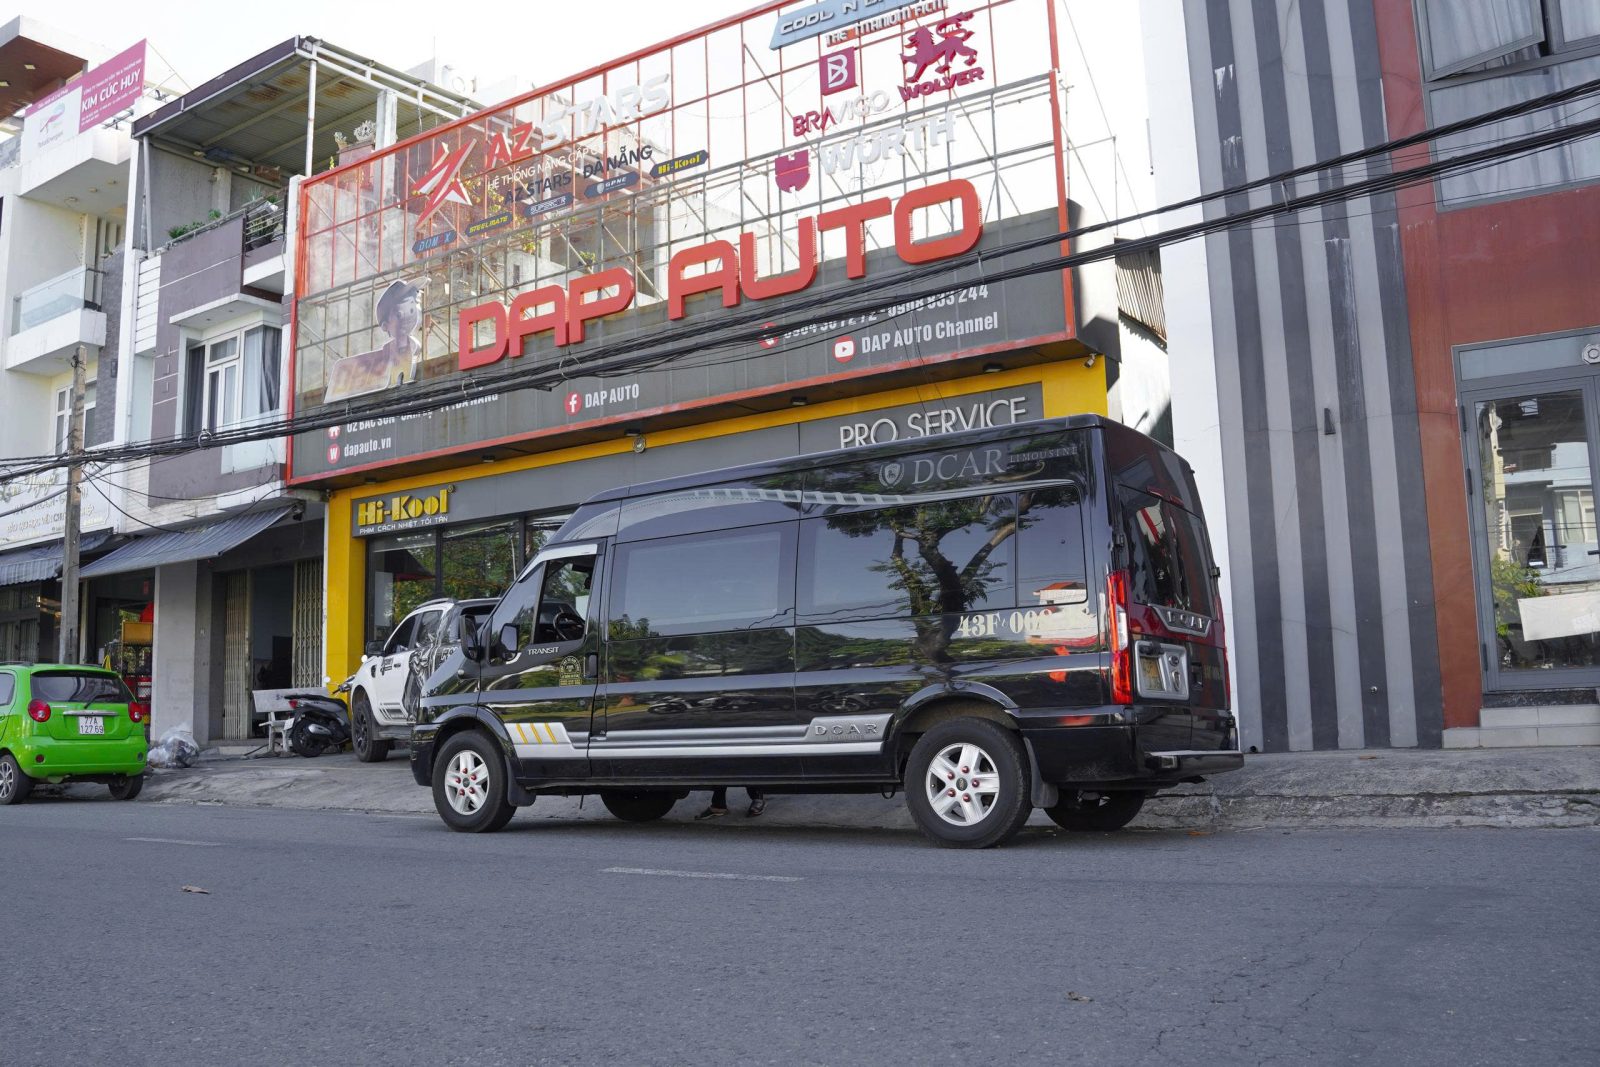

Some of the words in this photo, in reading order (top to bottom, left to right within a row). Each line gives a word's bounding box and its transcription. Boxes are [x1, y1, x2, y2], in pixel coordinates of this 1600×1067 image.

[779, 11, 834, 35] COOL
[81, 93, 98, 112] KIM
[99, 81, 119, 103] CÚC
[120, 68, 141, 91] HUY
[897, 66, 985, 101] WOLVER
[485, 122, 535, 171] AZ
[541, 73, 670, 150] STARS
[458, 267, 635, 371] DAP
[667, 178, 984, 321] AUTO
[957, 283, 989, 304] 244
[861, 333, 891, 354] DAP
[893, 319, 933, 347] AUTO
[935, 311, 998, 340] Channel
[585, 391, 608, 408] DAP
[609, 383, 640, 404] AUTO
[839, 418, 898, 449] PRO
[907, 396, 1027, 437] SERVICE
[343, 437, 392, 457] dapauto.vn
[911, 448, 1007, 486] DCAR
[1010, 446, 1079, 464] LIMOUSINE
[357, 488, 448, 527] Hi-Kool
[359, 527, 375, 535] PHIM
[528, 646, 560, 655] TRANSIT
[84, 716, 98, 725] 77A
[814, 722, 878, 735] DCAR
